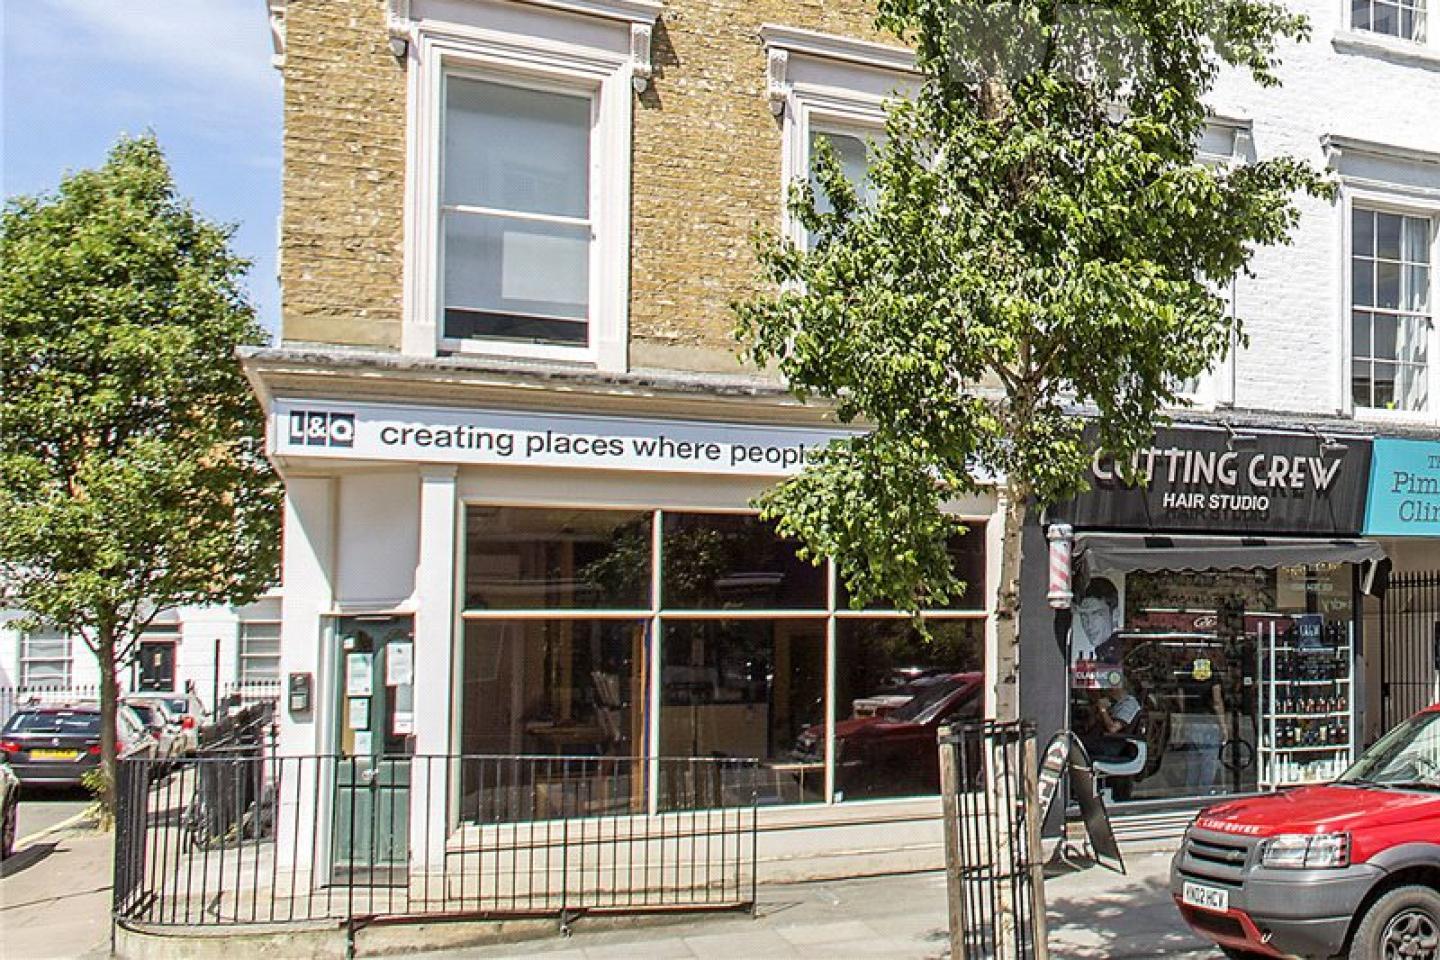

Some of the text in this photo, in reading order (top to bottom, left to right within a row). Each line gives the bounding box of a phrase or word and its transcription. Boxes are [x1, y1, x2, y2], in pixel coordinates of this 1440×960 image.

[290, 412, 355, 446] L&Q
[380, 426, 514, 456] creating
[525, 430, 624, 458] places
[631, 436, 721, 461] where
[1092, 446, 1342, 492] CUTTING CREW
[1162, 493, 1270, 511] HAIR STUDIO
